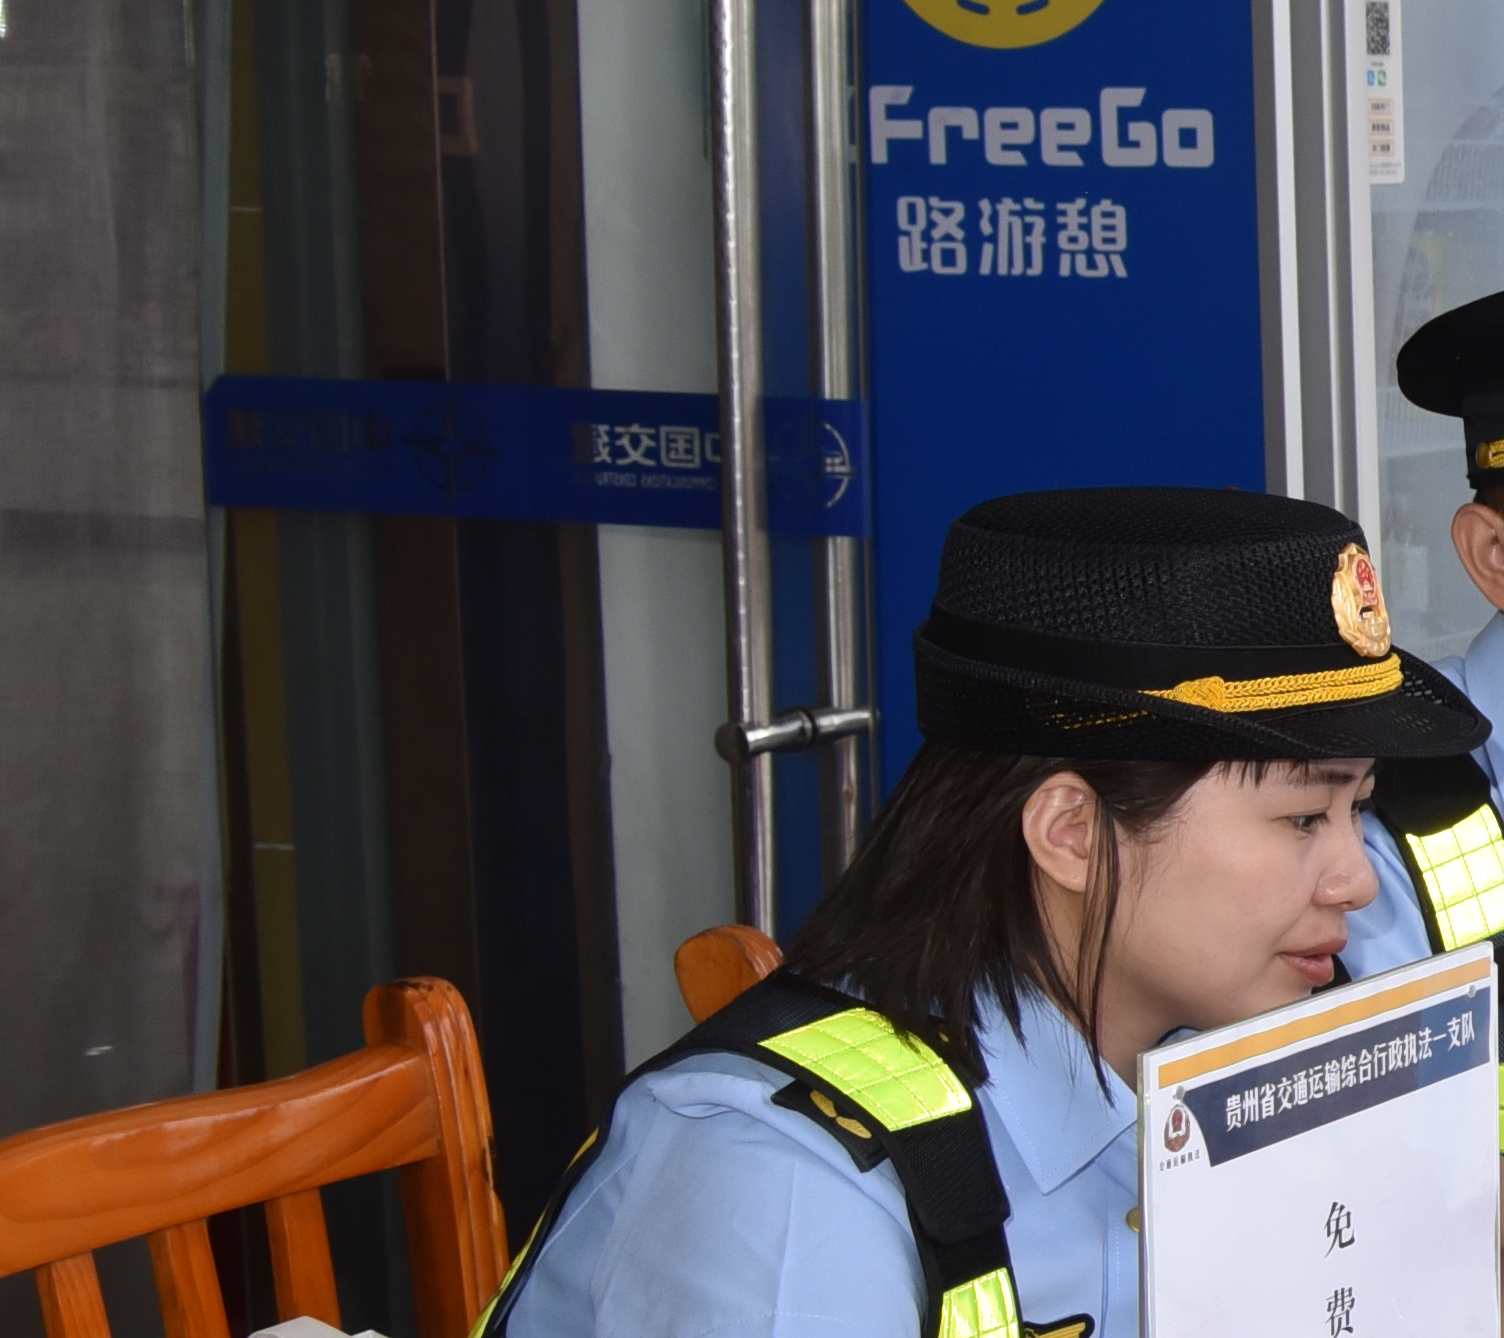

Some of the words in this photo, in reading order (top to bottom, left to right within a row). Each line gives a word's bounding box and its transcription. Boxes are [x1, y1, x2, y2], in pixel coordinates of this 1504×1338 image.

[845, 85, 1215, 169] FreeGo
[897, 195, 1129, 279] 路游憩
[1225, 1010, 1476, 1133] 贵州省交通运输综合行政执法一支队
[1159, 1149, 1201, 1171] 交通运输执法
